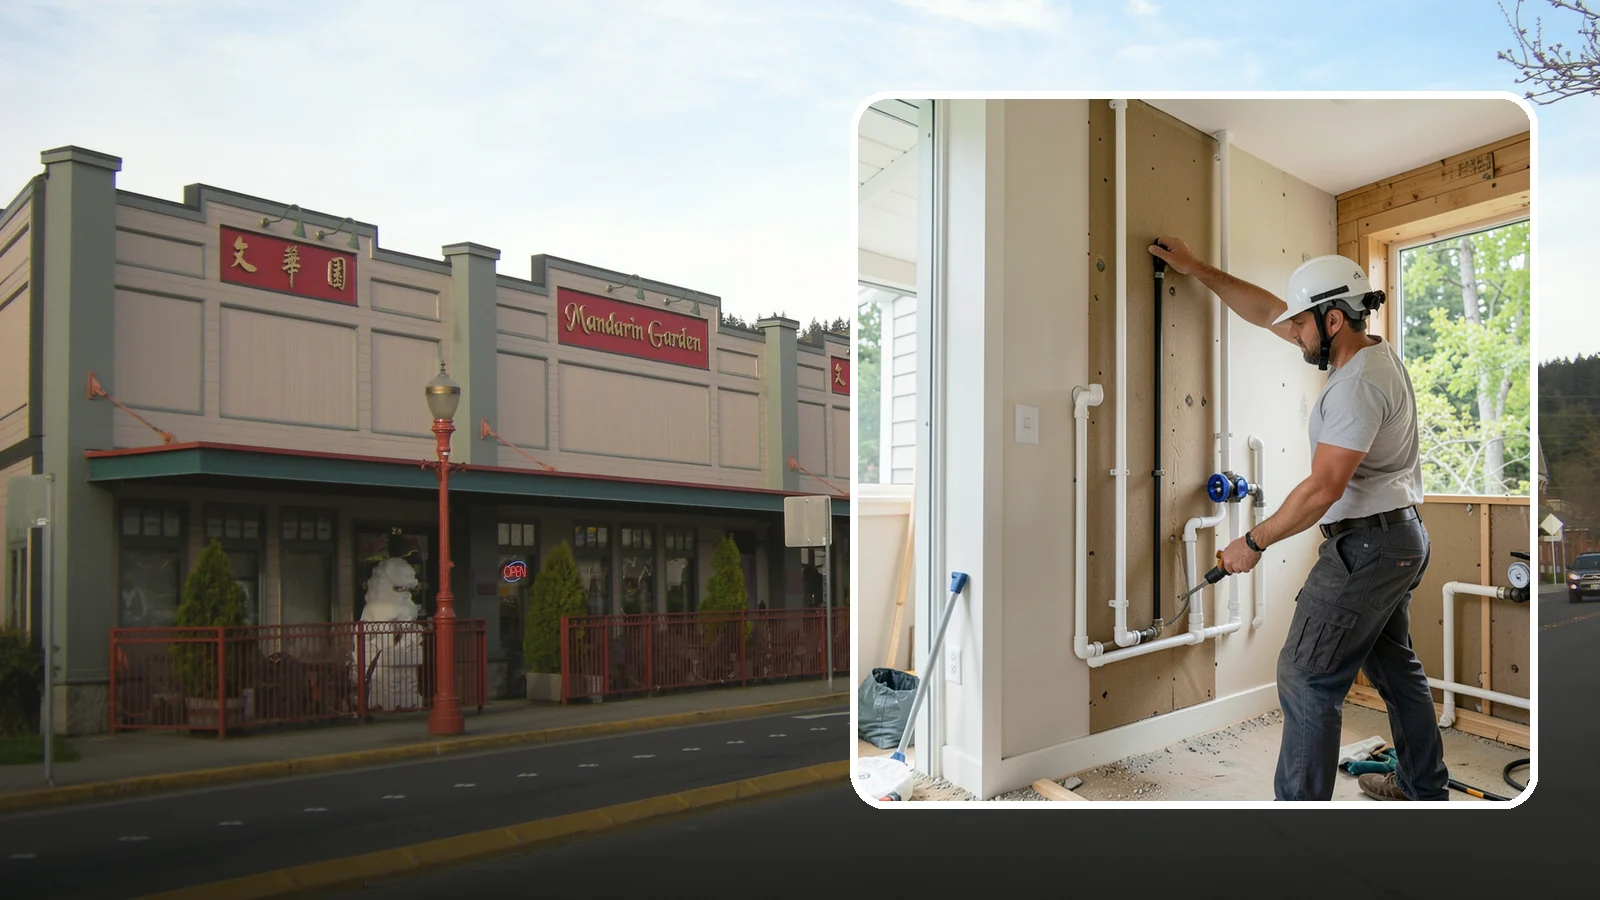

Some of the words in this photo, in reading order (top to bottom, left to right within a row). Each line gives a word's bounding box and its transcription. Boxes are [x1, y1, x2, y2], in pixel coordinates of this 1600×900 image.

[231, 236, 346, 291] 文華園
[564, 302, 644, 340] Mandarin
[648, 320, 702, 352] Garden
[503, 565, 527, 579] OPEN
